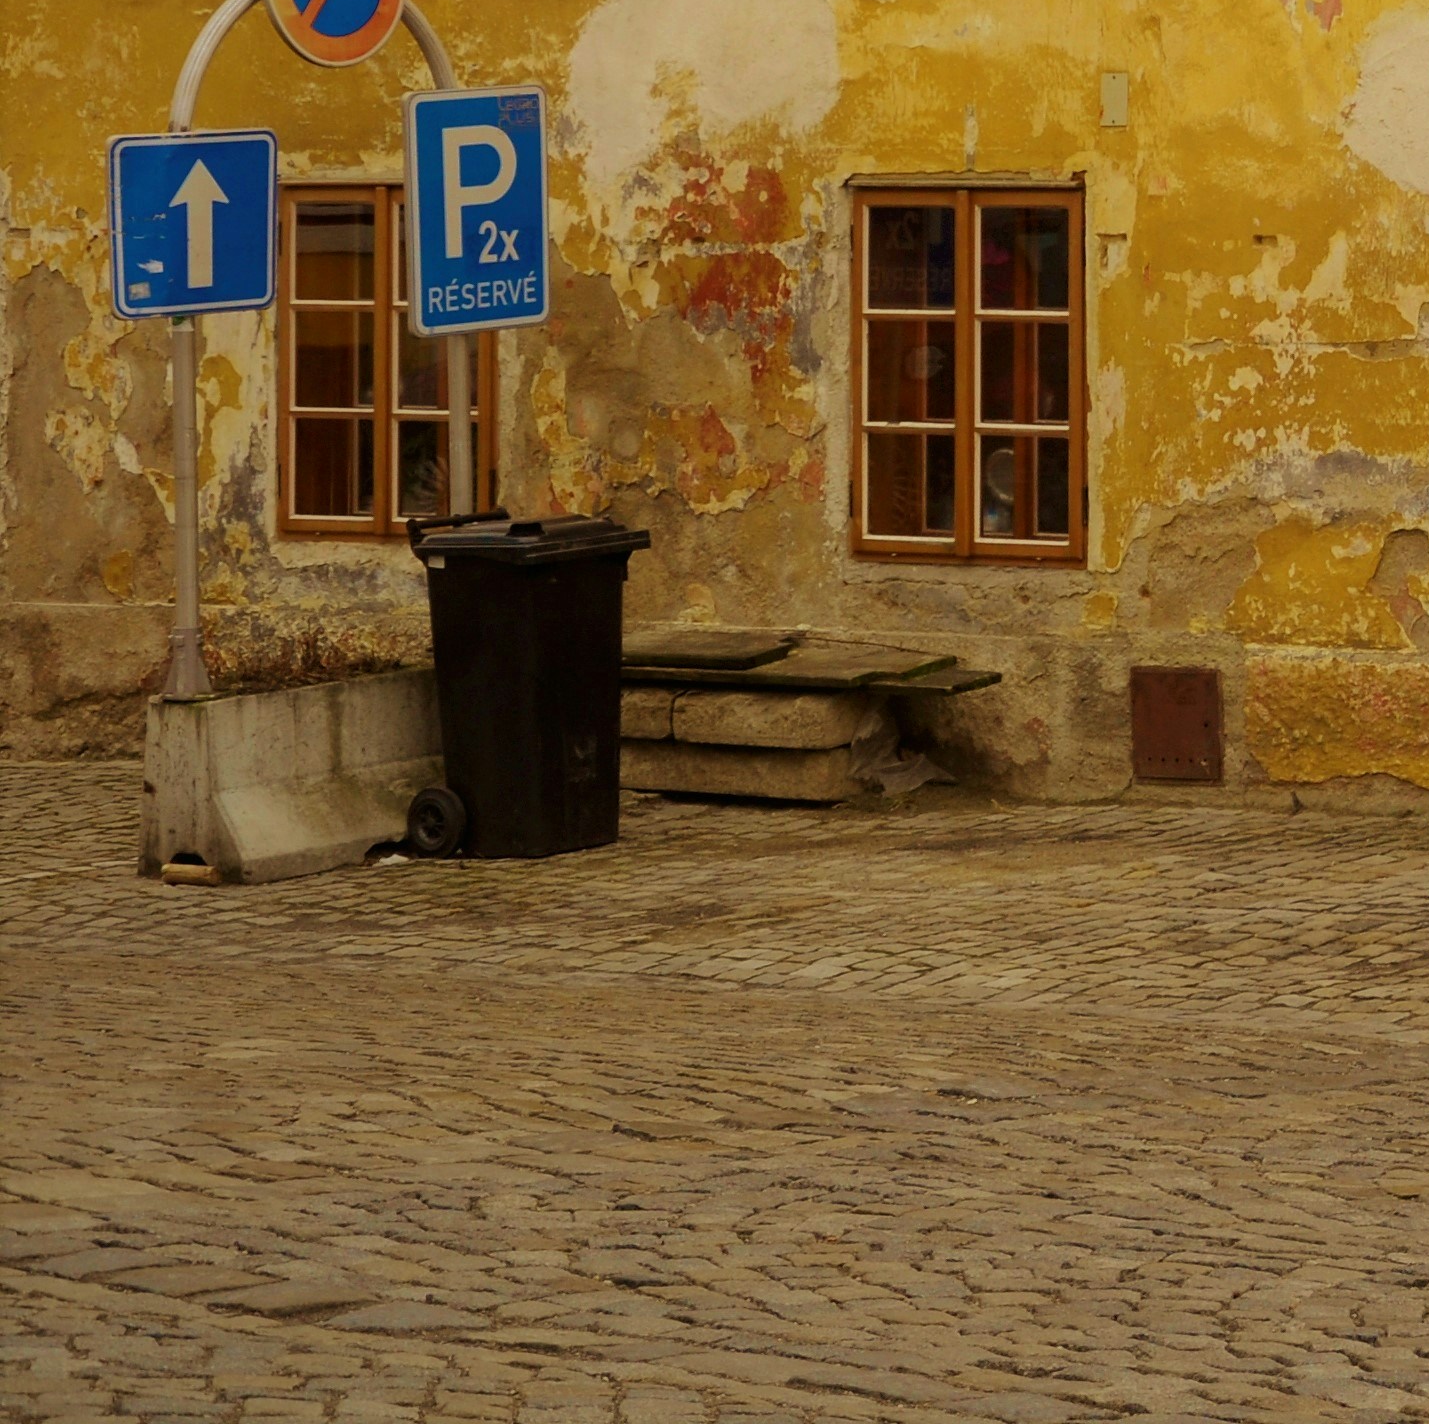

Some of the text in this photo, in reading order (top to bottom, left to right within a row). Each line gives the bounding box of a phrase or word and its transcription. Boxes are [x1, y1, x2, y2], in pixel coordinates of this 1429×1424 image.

[441, 124, 517, 259] P
[478, 220, 520, 264] 2x
[428, 271, 537, 313] RÉSERVÉ
